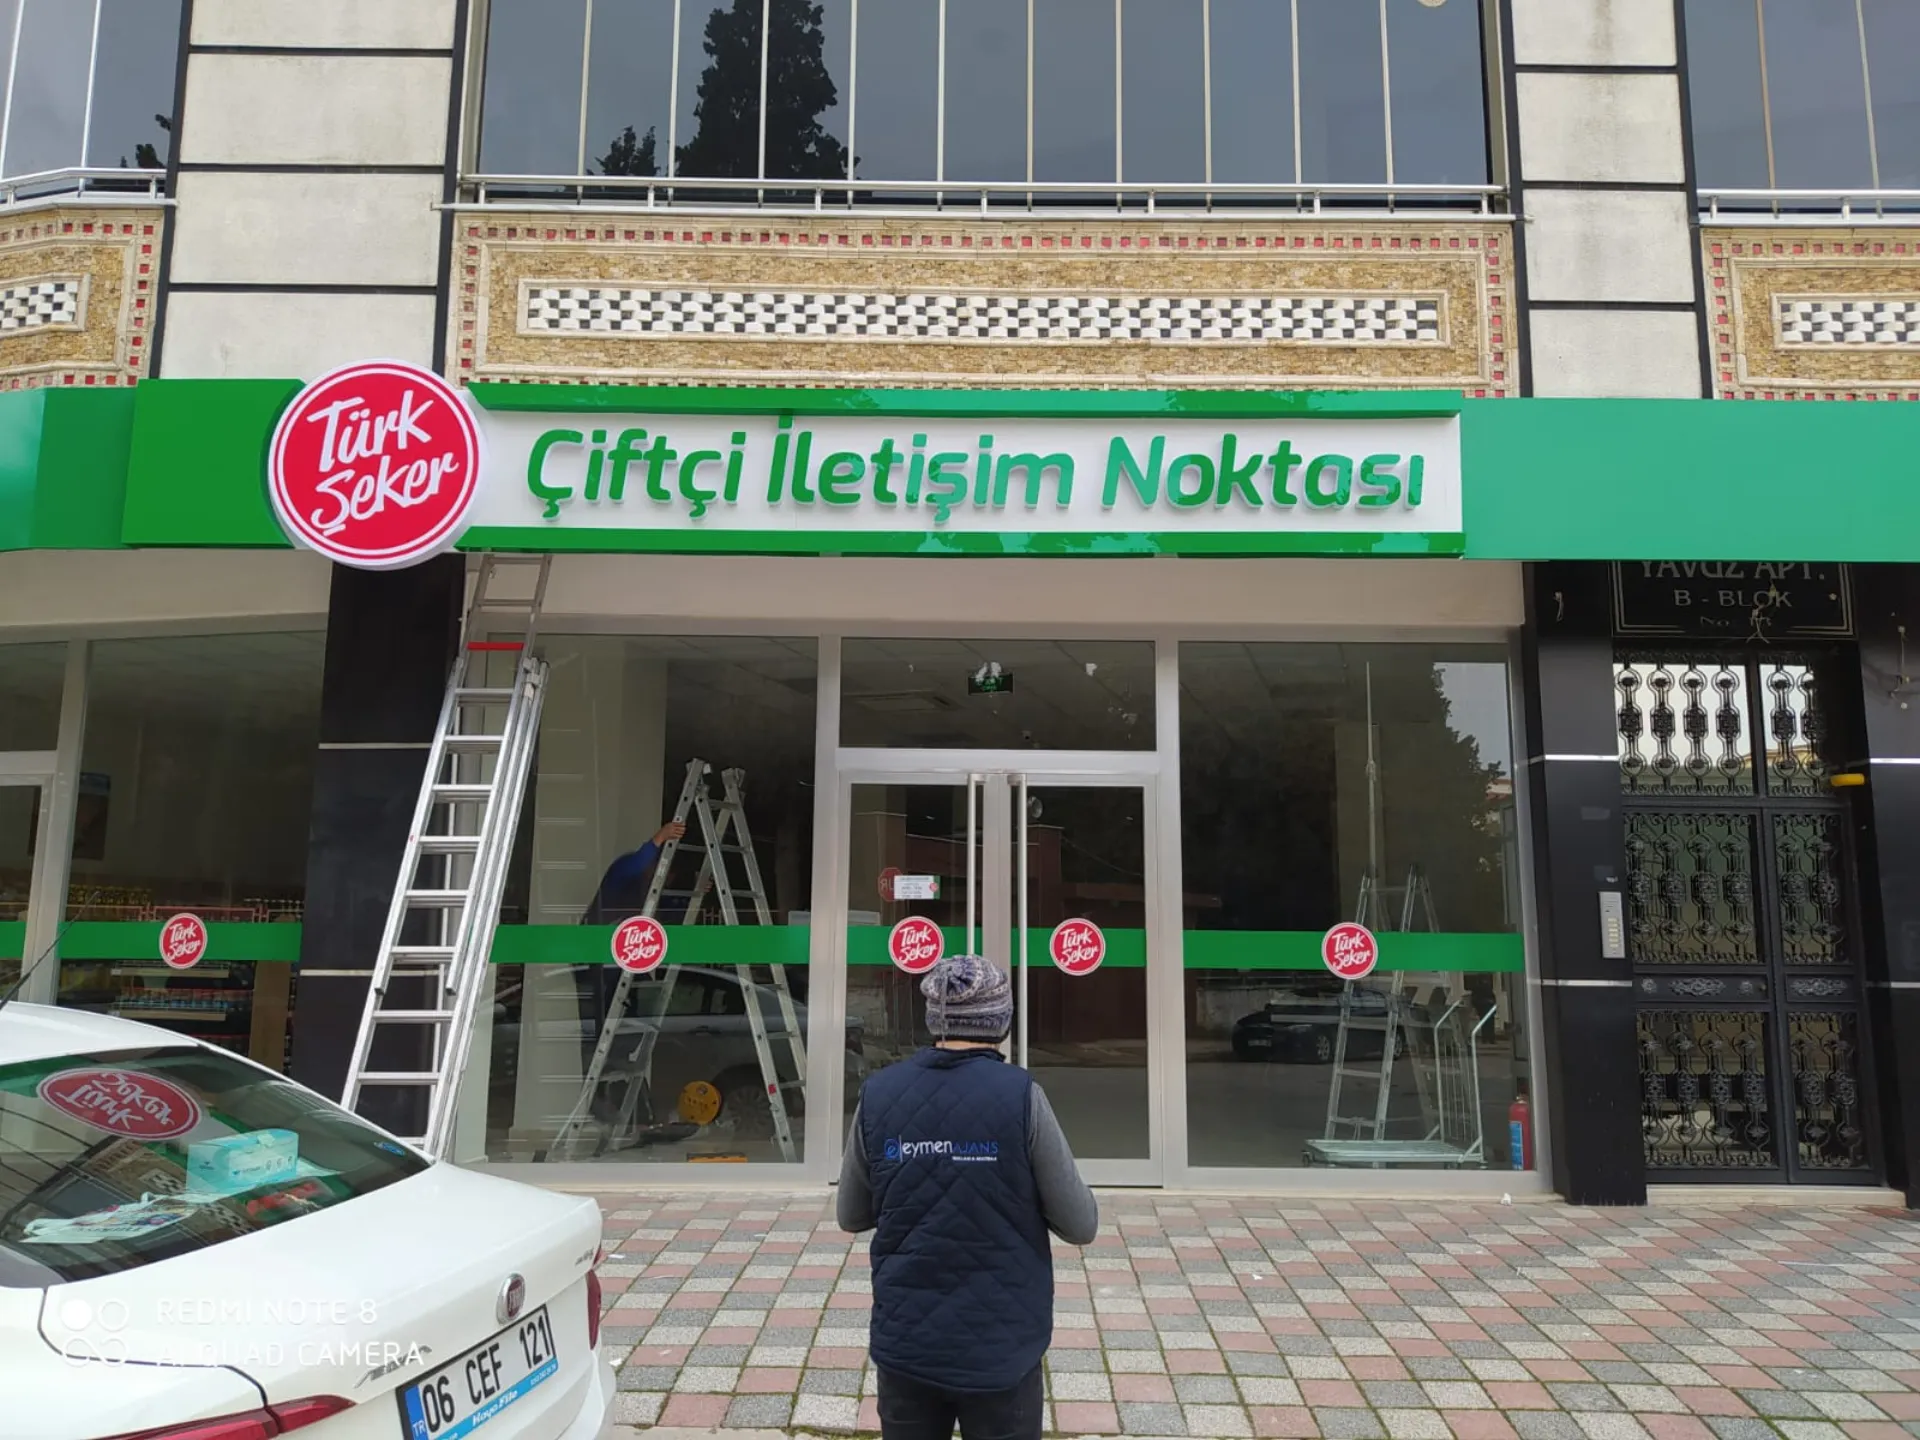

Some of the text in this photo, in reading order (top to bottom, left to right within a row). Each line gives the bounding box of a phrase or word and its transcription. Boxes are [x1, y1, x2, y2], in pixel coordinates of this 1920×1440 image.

[306, 389, 435, 473] Türk
[526, 410, 1425, 524] Çiftçi İletişim Noktası
[310, 452, 460, 537] Şeker
[1674, 589, 1692, 607] B
[1718, 590, 1793, 608] BLOK
[169, 921, 198, 944] Türk
[622, 924, 657, 947] Türk
[898, 924, 933, 948] Türk
[1059, 926, 1094, 949] Türk
[1331, 931, 1366, 954] Türk
[412, 1419, 427, 1438] TR
[421, 1374, 455, 1433] 06
[465, 1342, 502, 1405] CEF
[518, 1314, 551, 1369] 121
